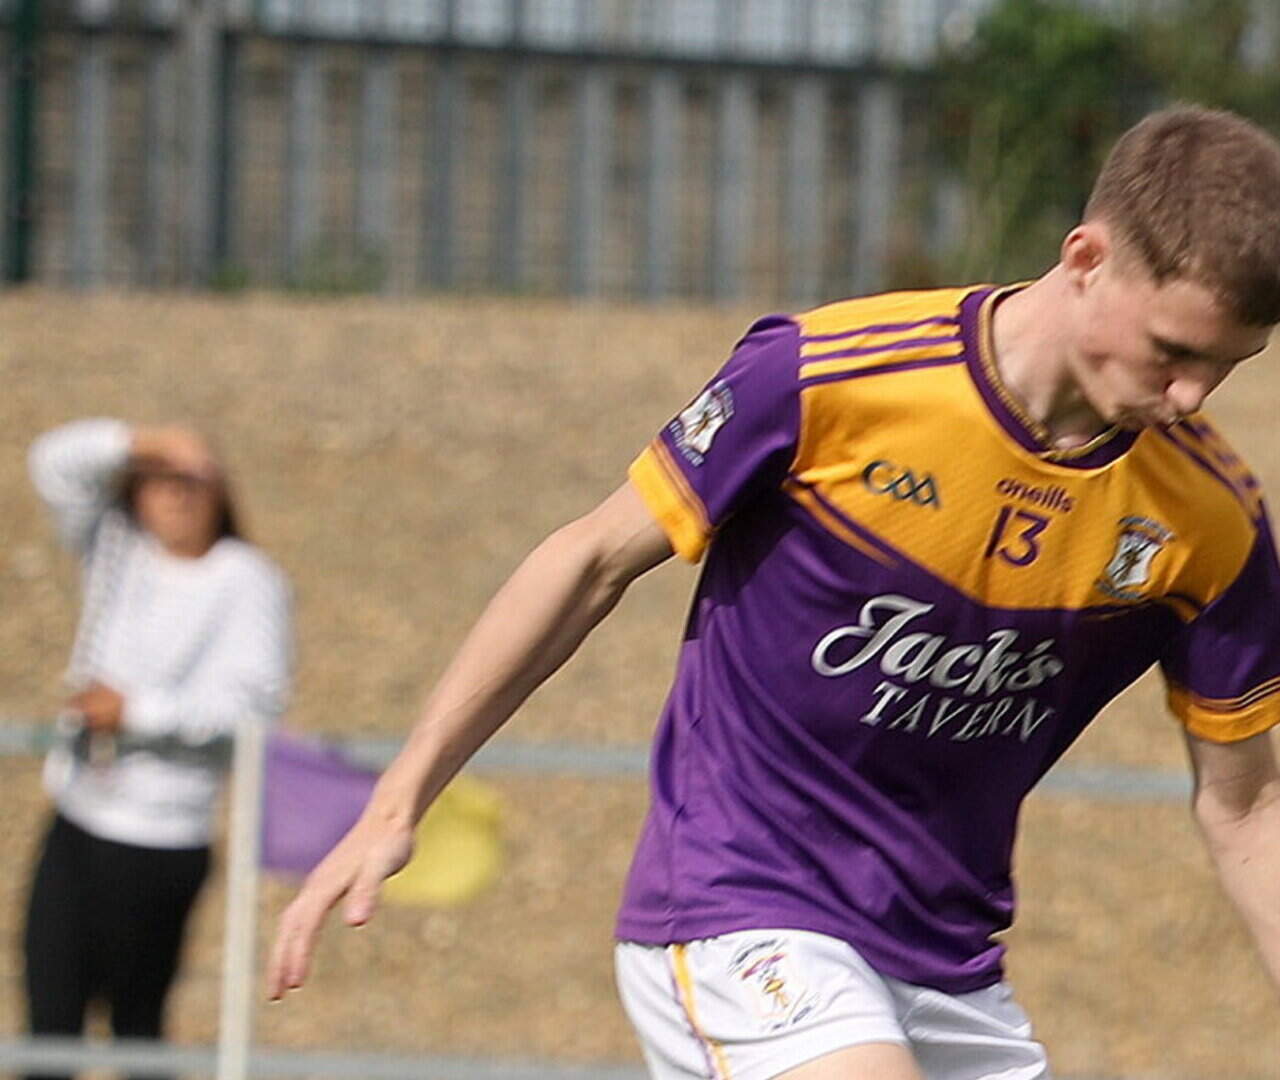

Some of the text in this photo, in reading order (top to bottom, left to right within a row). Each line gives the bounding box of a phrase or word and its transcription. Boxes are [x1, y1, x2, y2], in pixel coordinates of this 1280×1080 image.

[997, 478, 1074, 513] oneills
[984, 505, 1051, 567] 13
[811, 594, 1064, 697] Jack's
[859, 681, 1055, 744] TAVERN
